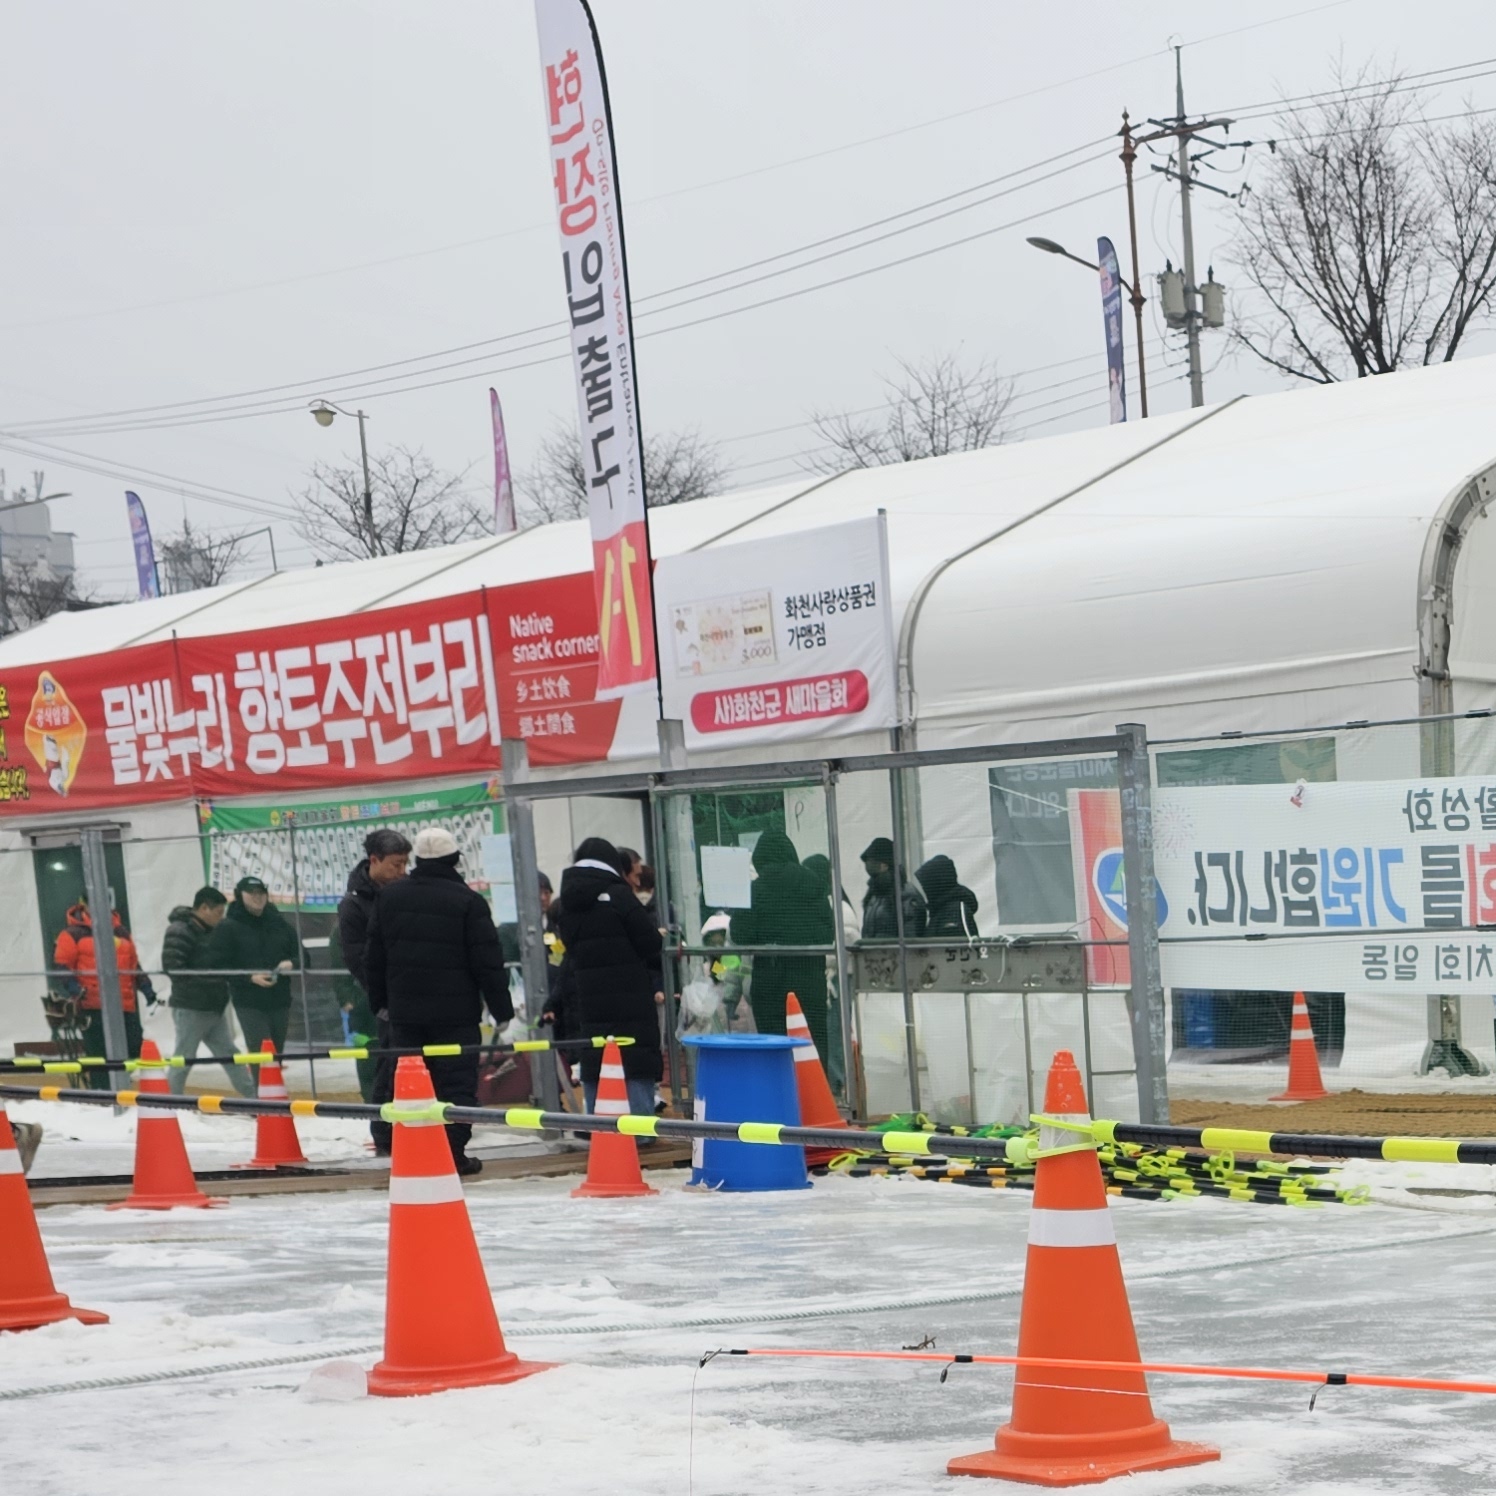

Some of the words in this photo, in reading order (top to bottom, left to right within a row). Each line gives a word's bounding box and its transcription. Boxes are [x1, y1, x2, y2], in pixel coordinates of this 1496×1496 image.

[784, 581, 876, 621] 화천사랑상품권
[509, 612, 554, 639] Native
[787, 622, 827, 651] 가맹점
[512, 636, 553, 664] snack
[554, 633, 600, 658] corner
[101, 672, 235, 786] 물빛누리
[239, 614, 501, 775] 향토주전부리
[785, 677, 848, 716] 새마을회
